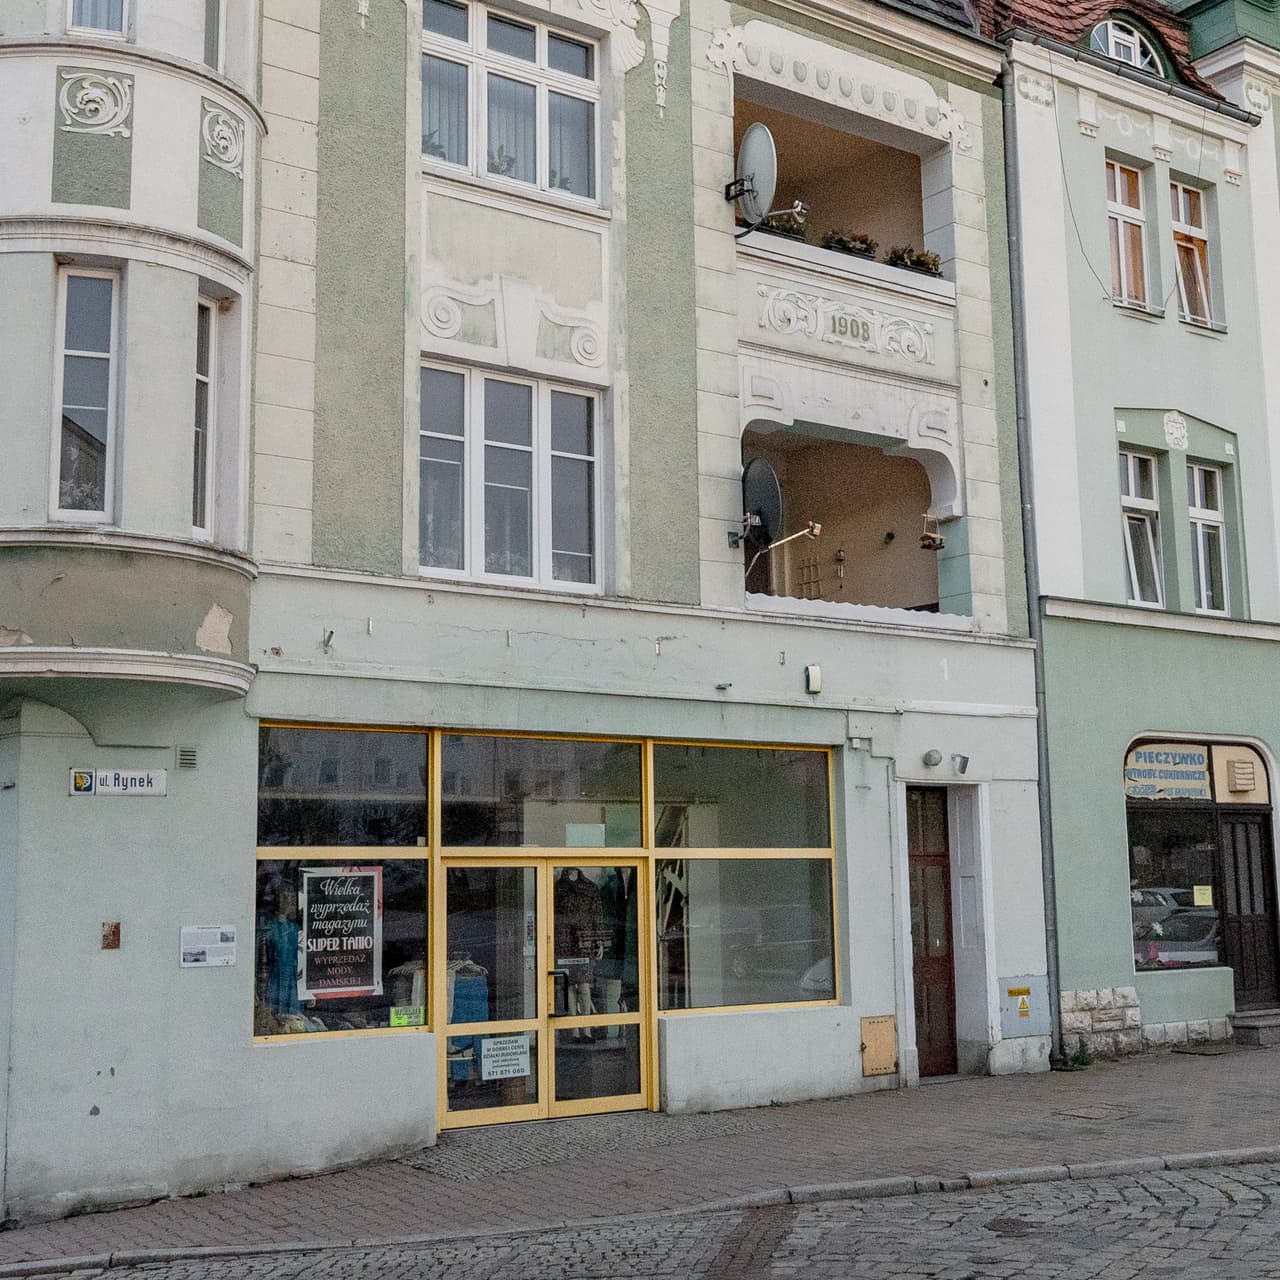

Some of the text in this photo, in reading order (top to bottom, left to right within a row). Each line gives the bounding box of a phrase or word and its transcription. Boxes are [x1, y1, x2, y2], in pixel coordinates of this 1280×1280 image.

[831, 314, 870, 342] 1908
[1135, 751, 1205, 766] PIECZYWKO
[99, 773, 153, 791] ul. Rynek
[320, 877, 360, 896] Wielka
[310, 896, 371, 919] wyprzedaż
[312, 919, 368, 935] magazynu
[306, 936, 373, 952] SUPER TANIO
[315, 954, 366, 965] WYPRZEDAŻ
[327, 966, 353, 976] MODY
